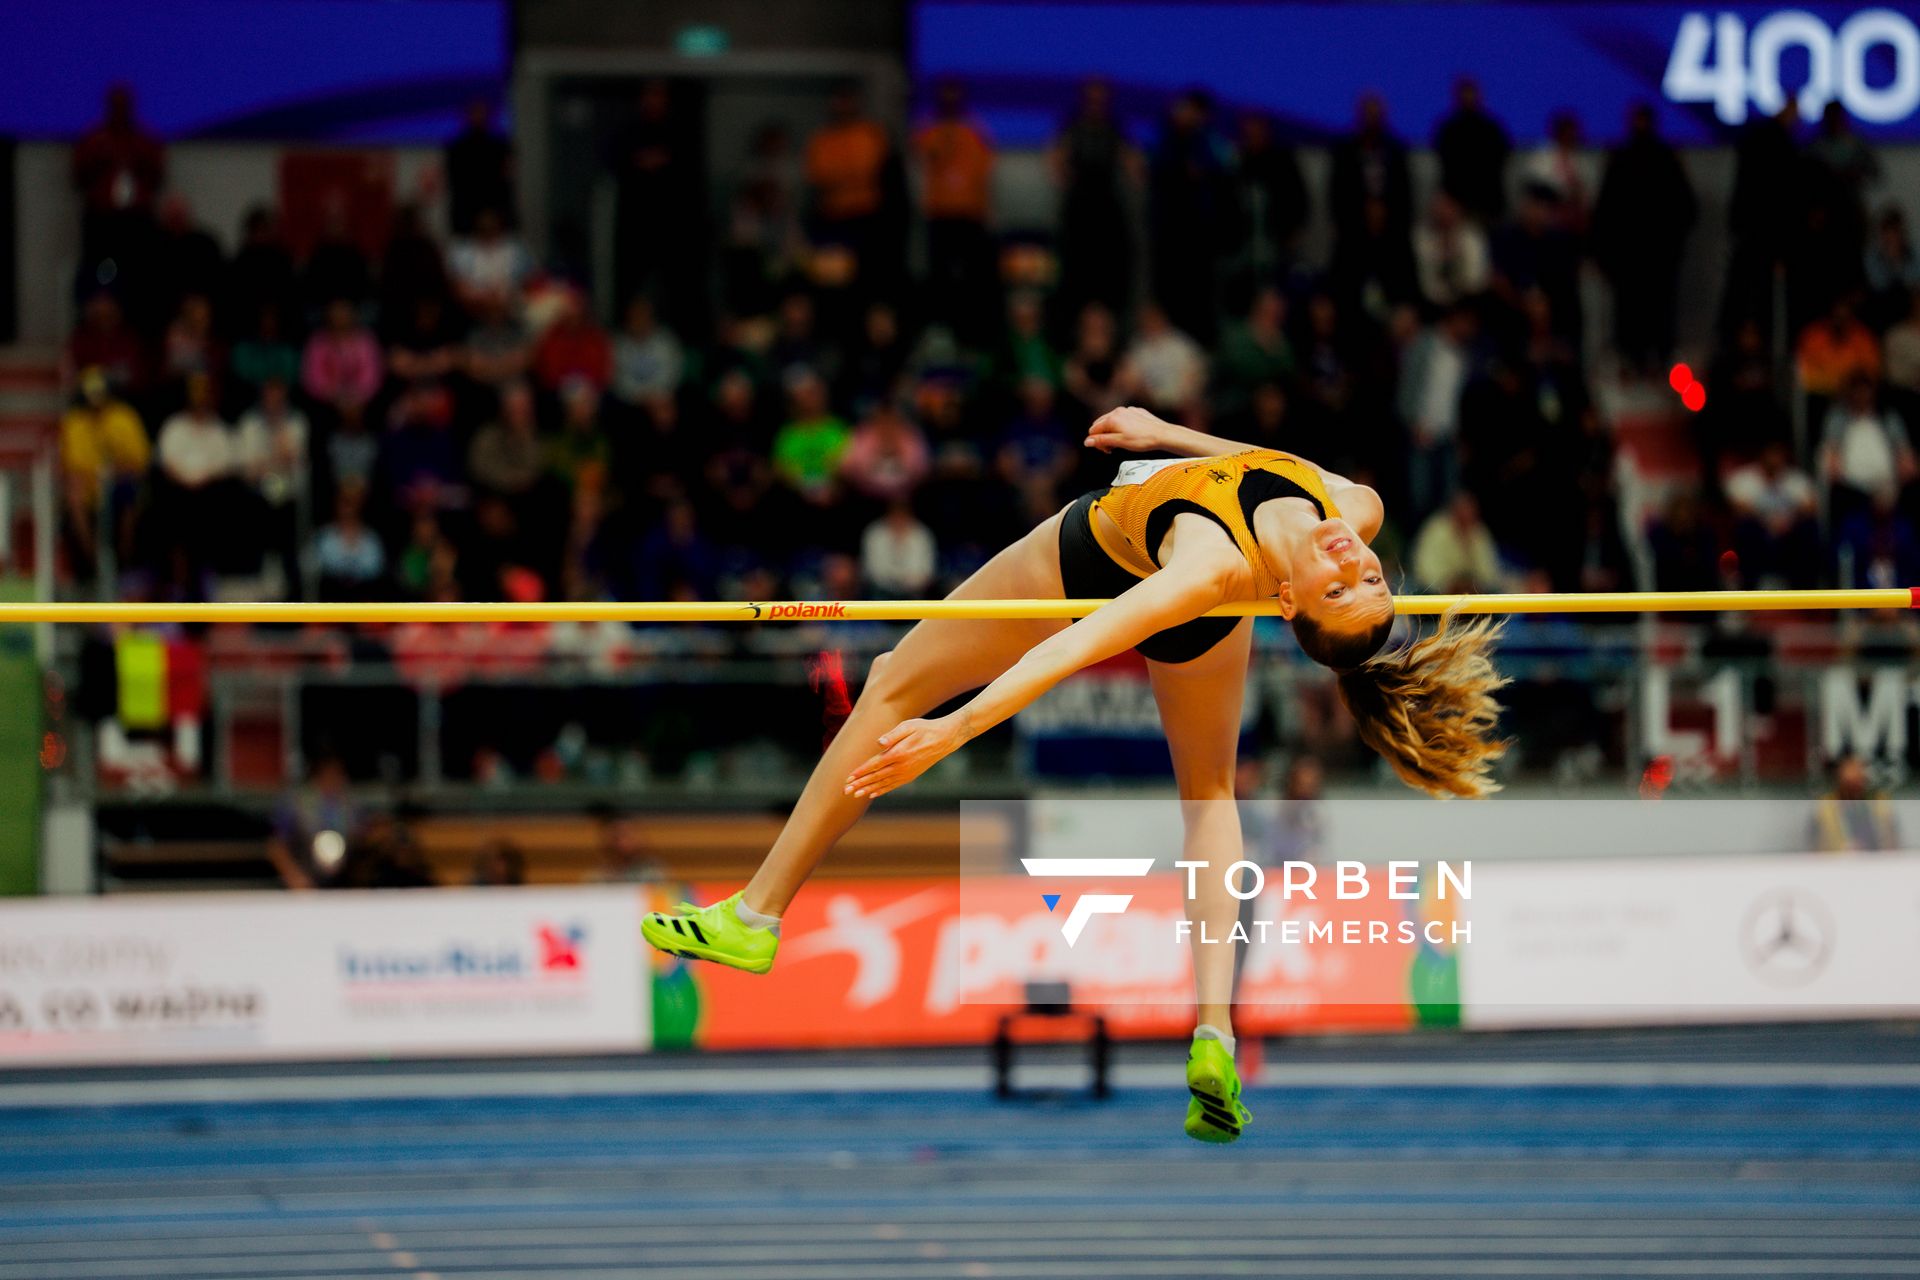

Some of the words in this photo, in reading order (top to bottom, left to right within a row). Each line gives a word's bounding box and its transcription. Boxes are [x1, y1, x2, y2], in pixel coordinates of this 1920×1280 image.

[1661, 8, 1920, 125] 400
[769, 602, 846, 620] polanik
[1822, 667, 1920, 758] M
[925, 888, 1316, 1017] polank
